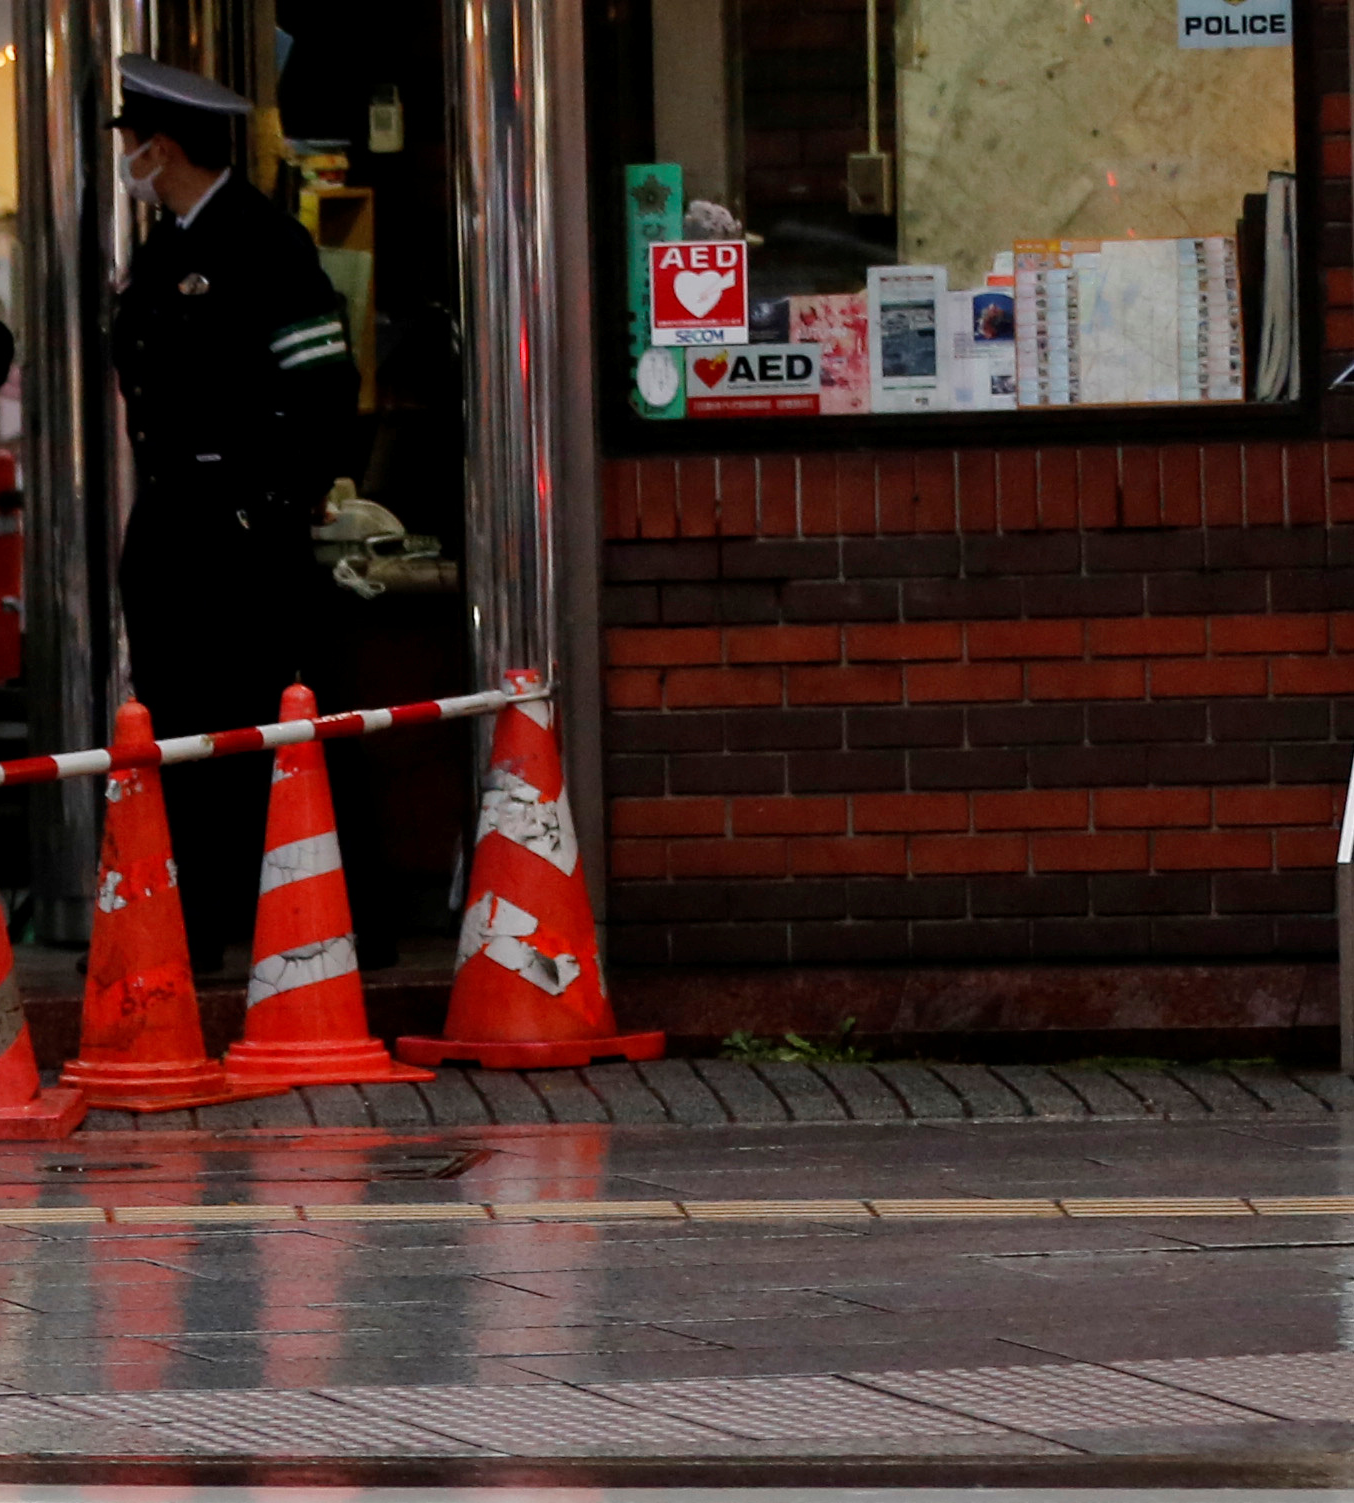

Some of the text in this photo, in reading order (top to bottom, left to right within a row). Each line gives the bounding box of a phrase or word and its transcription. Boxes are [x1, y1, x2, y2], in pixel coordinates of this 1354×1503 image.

[1184, 14, 1287, 36] POLICE
[658, 245, 739, 270] AED
[675, 329, 725, 343] SECOM
[728, 354, 813, 382] AED
